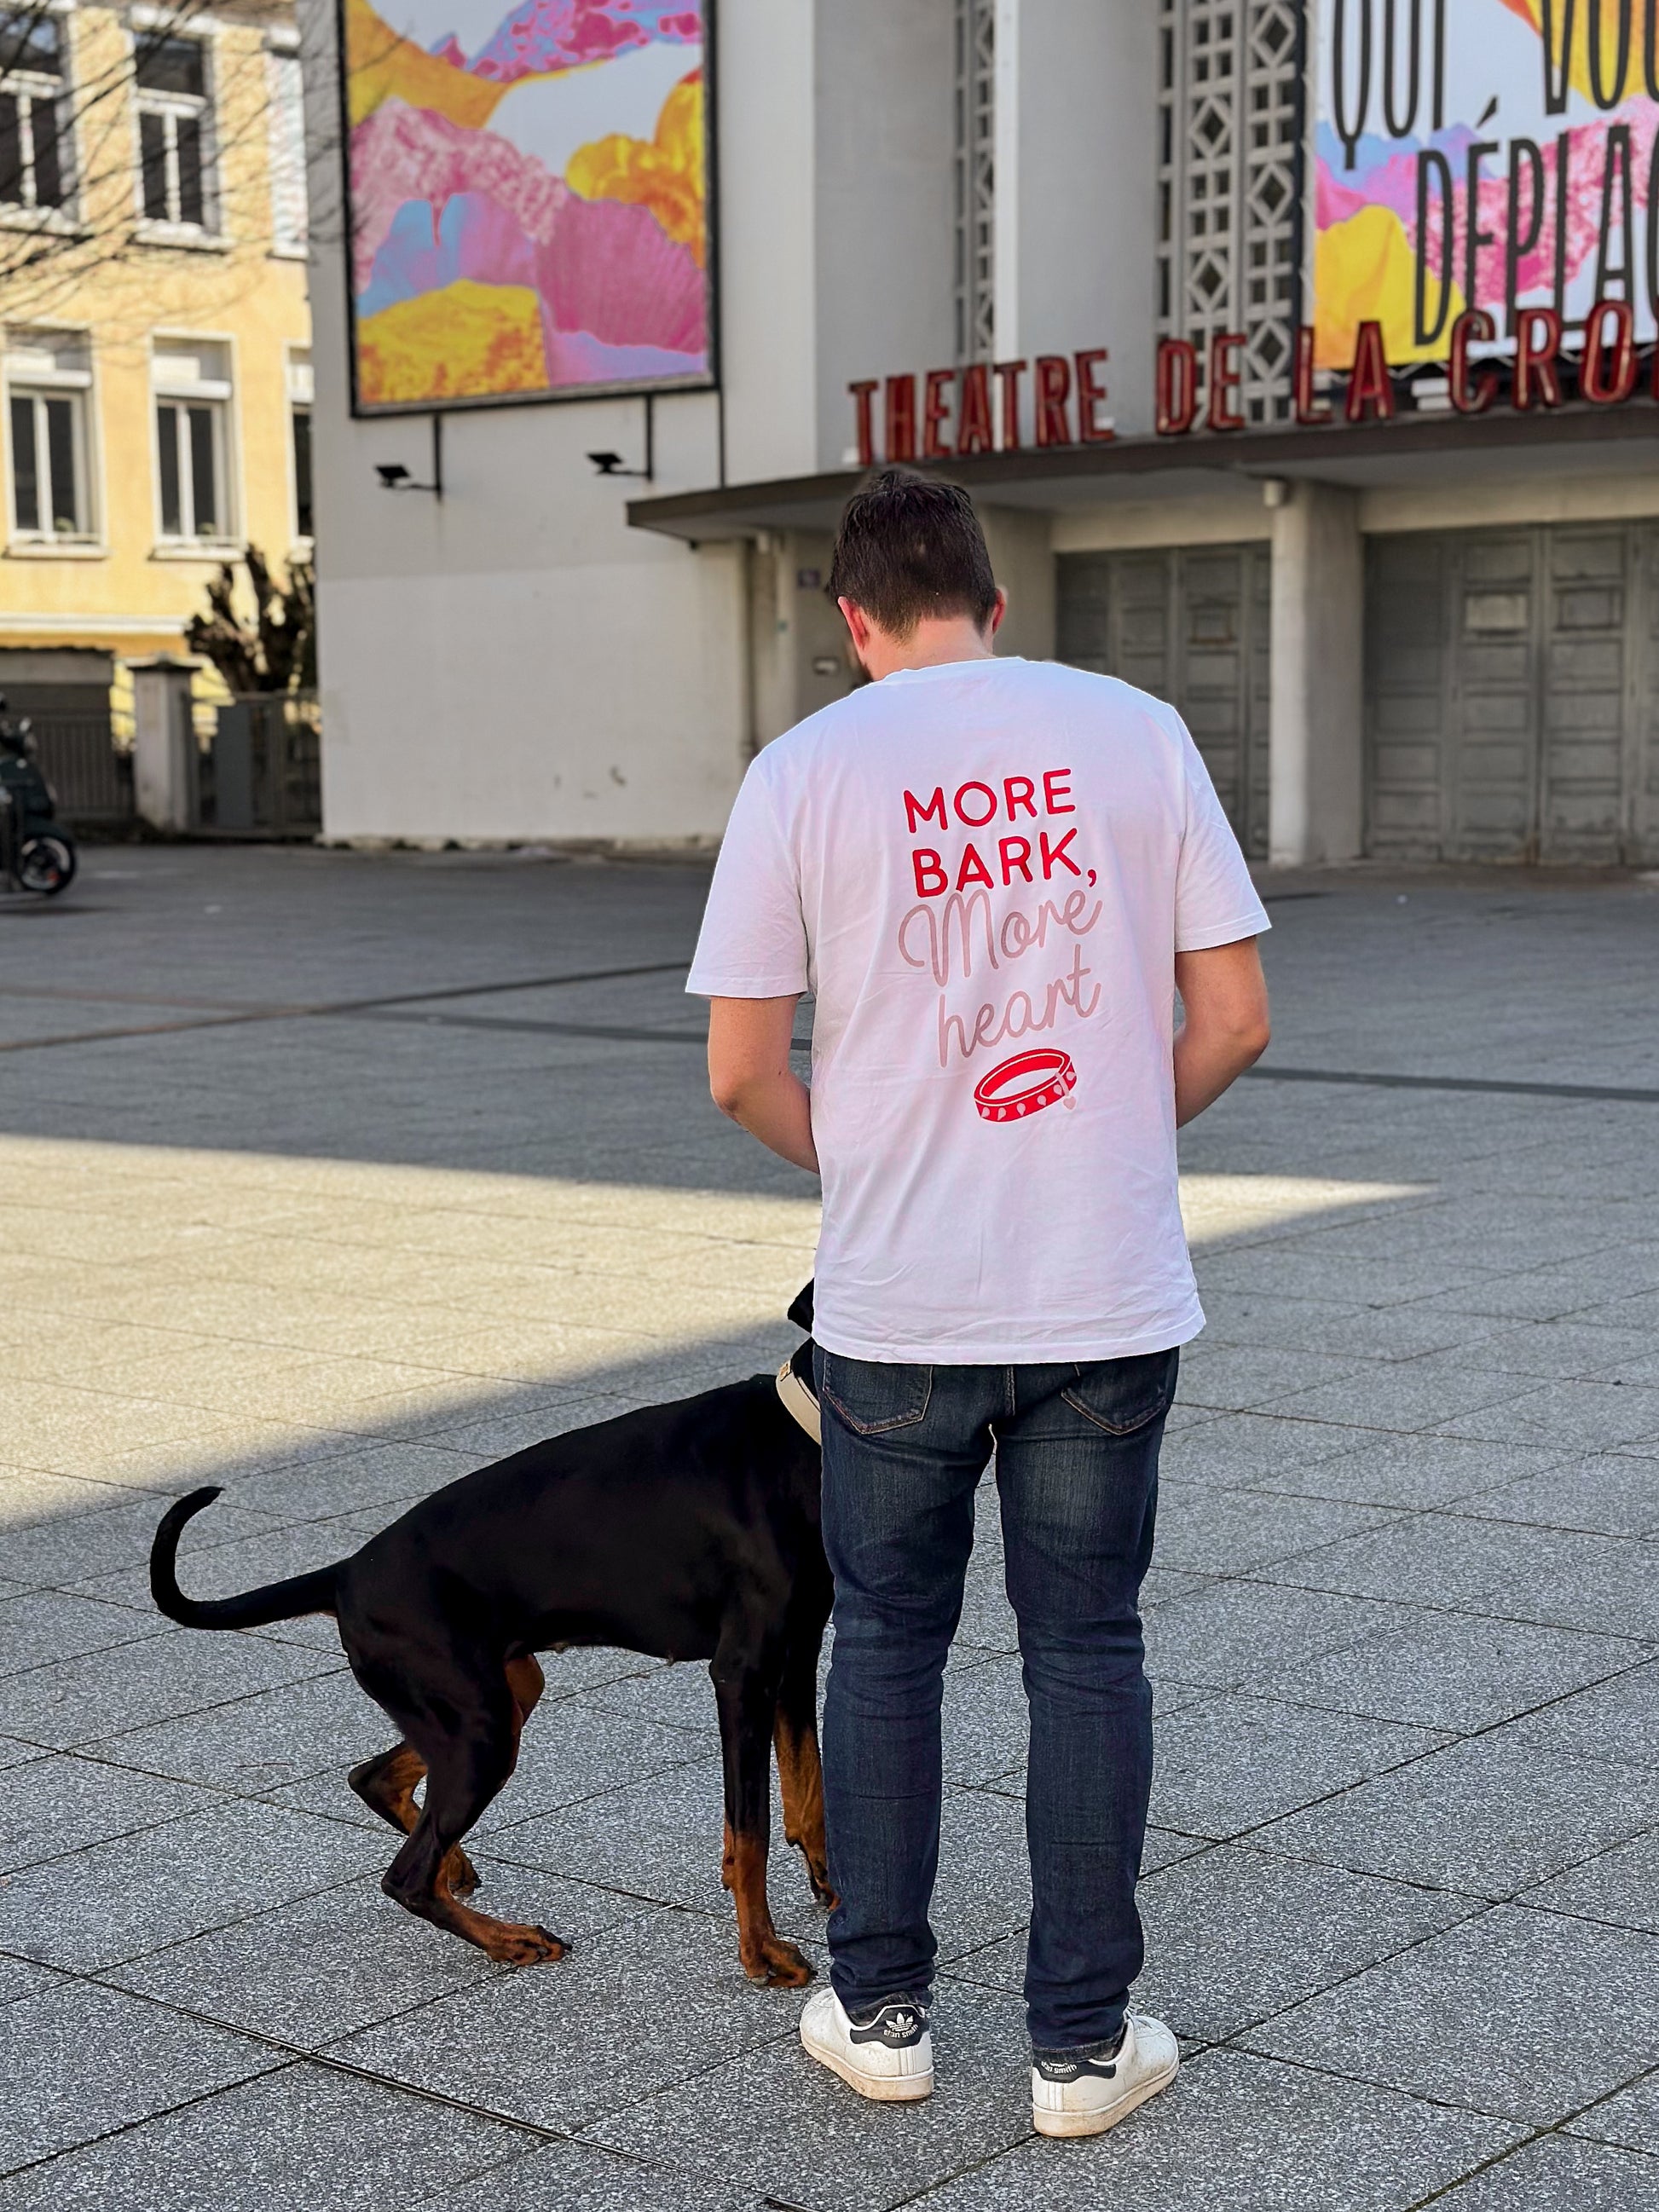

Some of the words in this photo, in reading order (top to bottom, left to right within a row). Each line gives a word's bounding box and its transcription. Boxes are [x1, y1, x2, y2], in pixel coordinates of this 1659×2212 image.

[848, 349, 1115, 465] THEATRE
[1156, 333, 1247, 436] DE
[1293, 321, 1396, 424] LA
[903, 768, 1076, 834] MORE
[911, 828, 1097, 898] BARK,
[898, 889, 1102, 987] More
[939, 943, 1101, 1069] heart
